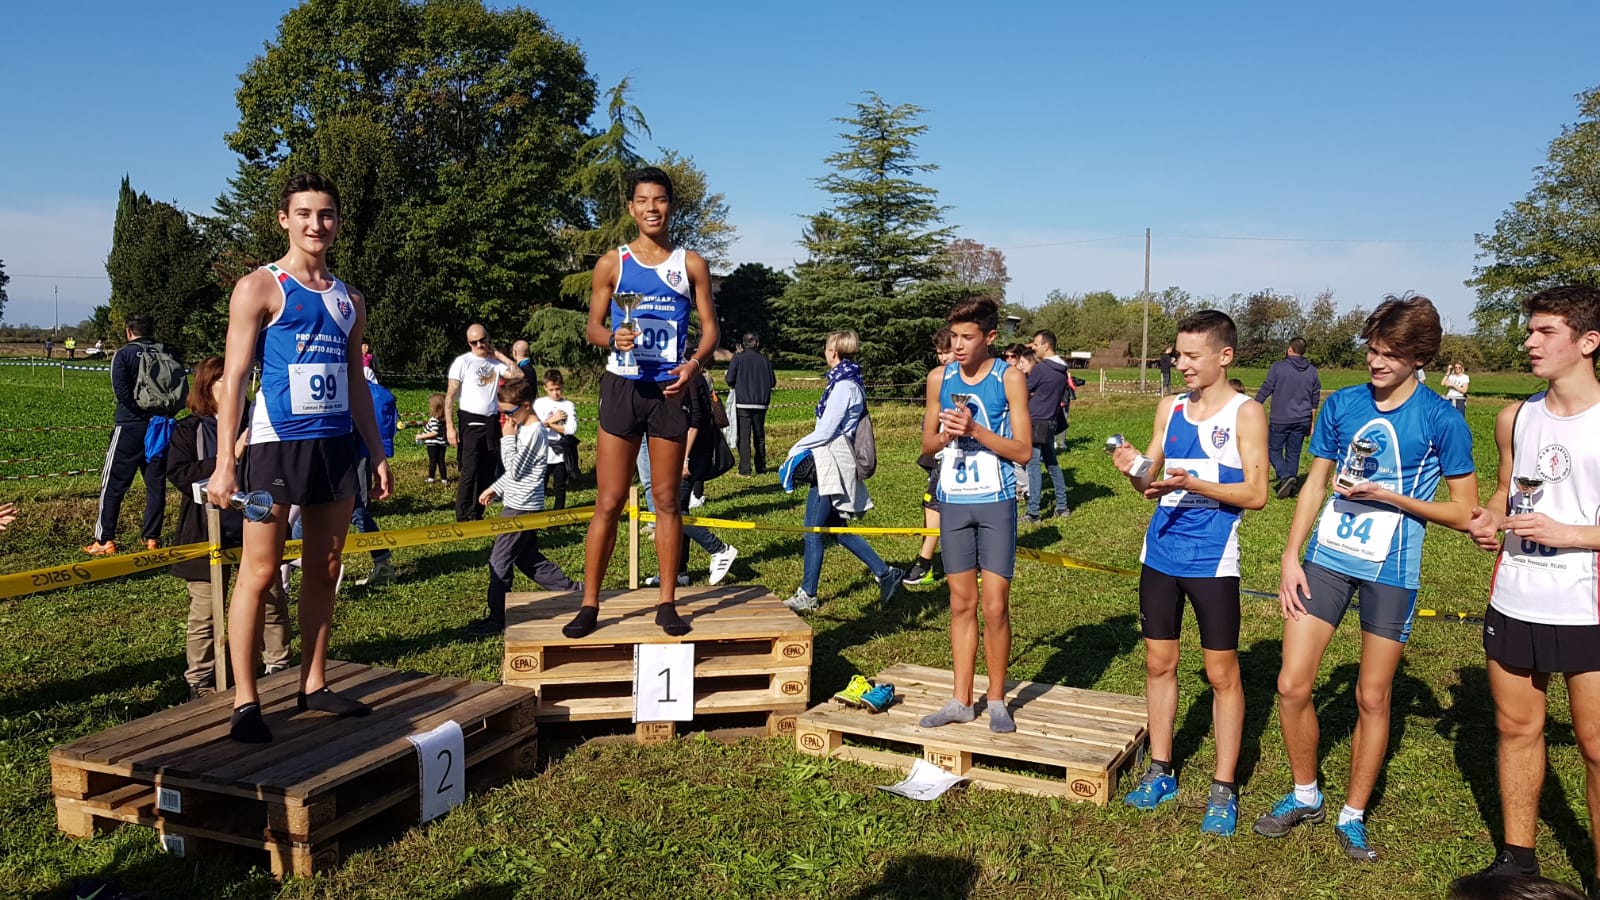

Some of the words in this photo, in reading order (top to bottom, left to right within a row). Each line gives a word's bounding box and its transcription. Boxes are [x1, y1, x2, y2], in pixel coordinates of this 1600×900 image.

[295, 333, 310, 341] PRO
[310, 374, 337, 400] 99
[955, 459, 980, 484] 81
[1336, 511, 1374, 545] 84
[786, 647, 801, 656] EPAL
[514, 658, 534, 669] EPAL
[658, 667, 678, 702] 1
[784, 683, 799, 692] EPAL
[780, 719, 796, 729] EPAL
[804, 737, 821, 748] EPAL
[437, 749, 453, 794] 2
[1074, 782, 1093, 794] EPAL
